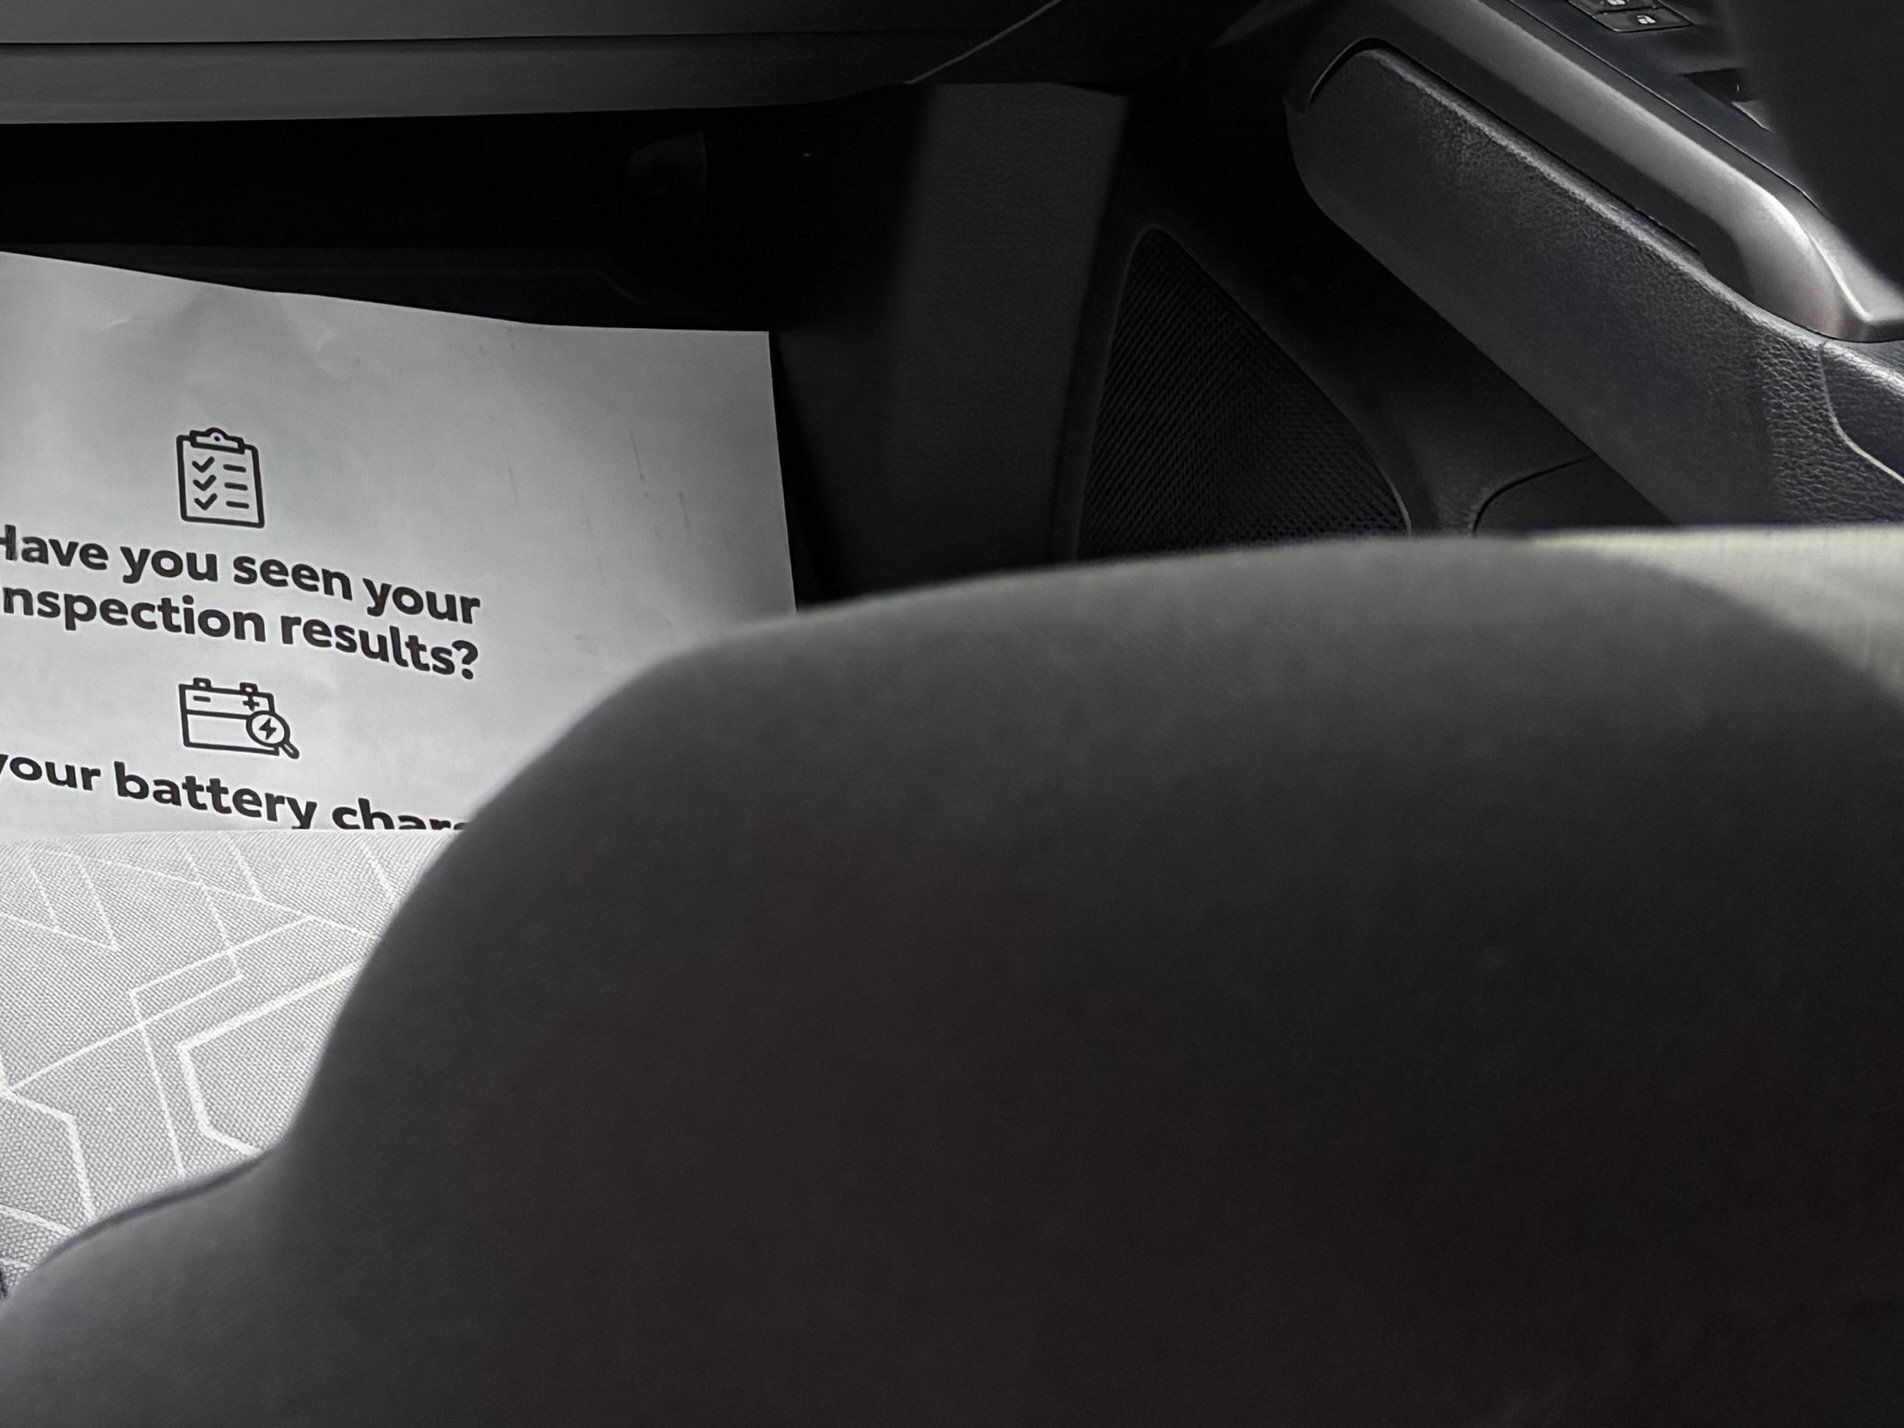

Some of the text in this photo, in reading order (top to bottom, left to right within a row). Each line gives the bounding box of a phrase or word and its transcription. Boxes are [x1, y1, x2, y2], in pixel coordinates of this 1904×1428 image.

[120, 544, 218, 586] you
[233, 549, 354, 602] seen
[363, 576, 481, 625] your
[280, 611, 480, 681] results?
[114, 760, 319, 831] battery
